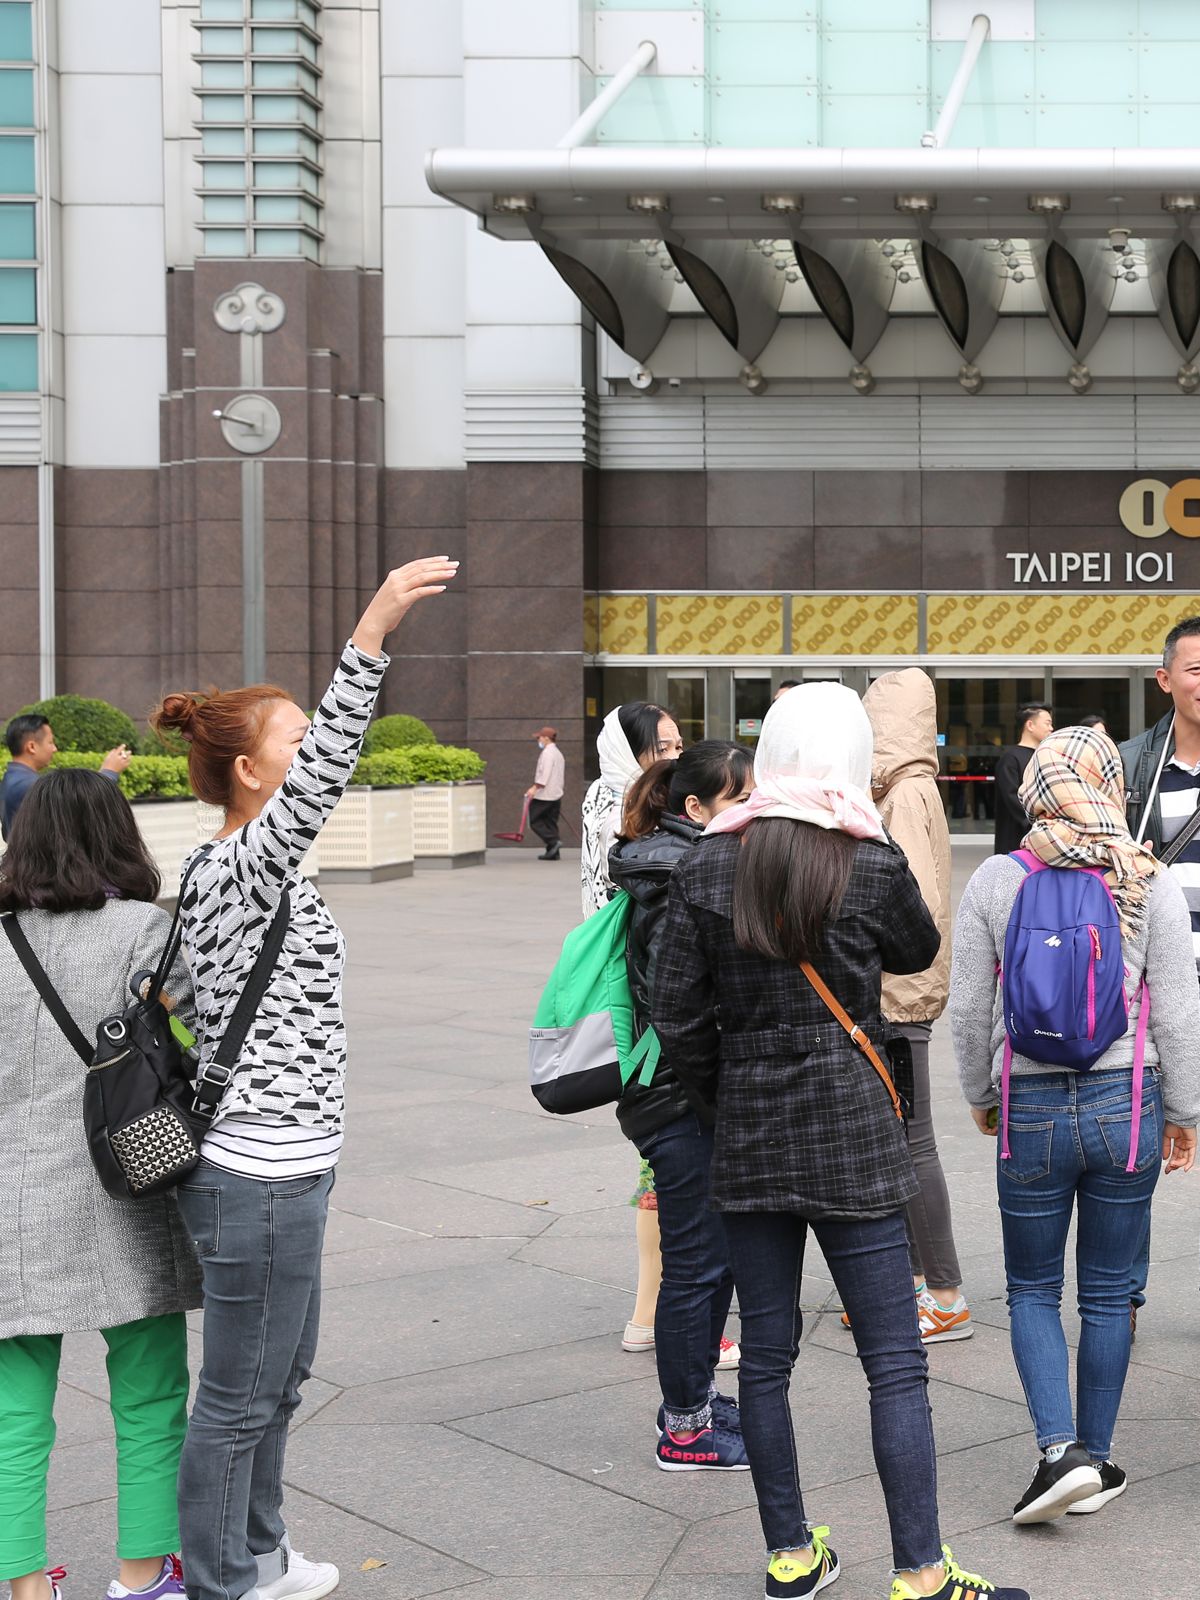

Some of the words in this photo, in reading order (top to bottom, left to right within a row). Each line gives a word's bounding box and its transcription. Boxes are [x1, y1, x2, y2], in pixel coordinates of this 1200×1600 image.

[1006, 552, 1111, 583] TAIPEI
[1034, 1029, 1063, 1038] Quechua
[660, 1445, 718, 1462] Kappa
